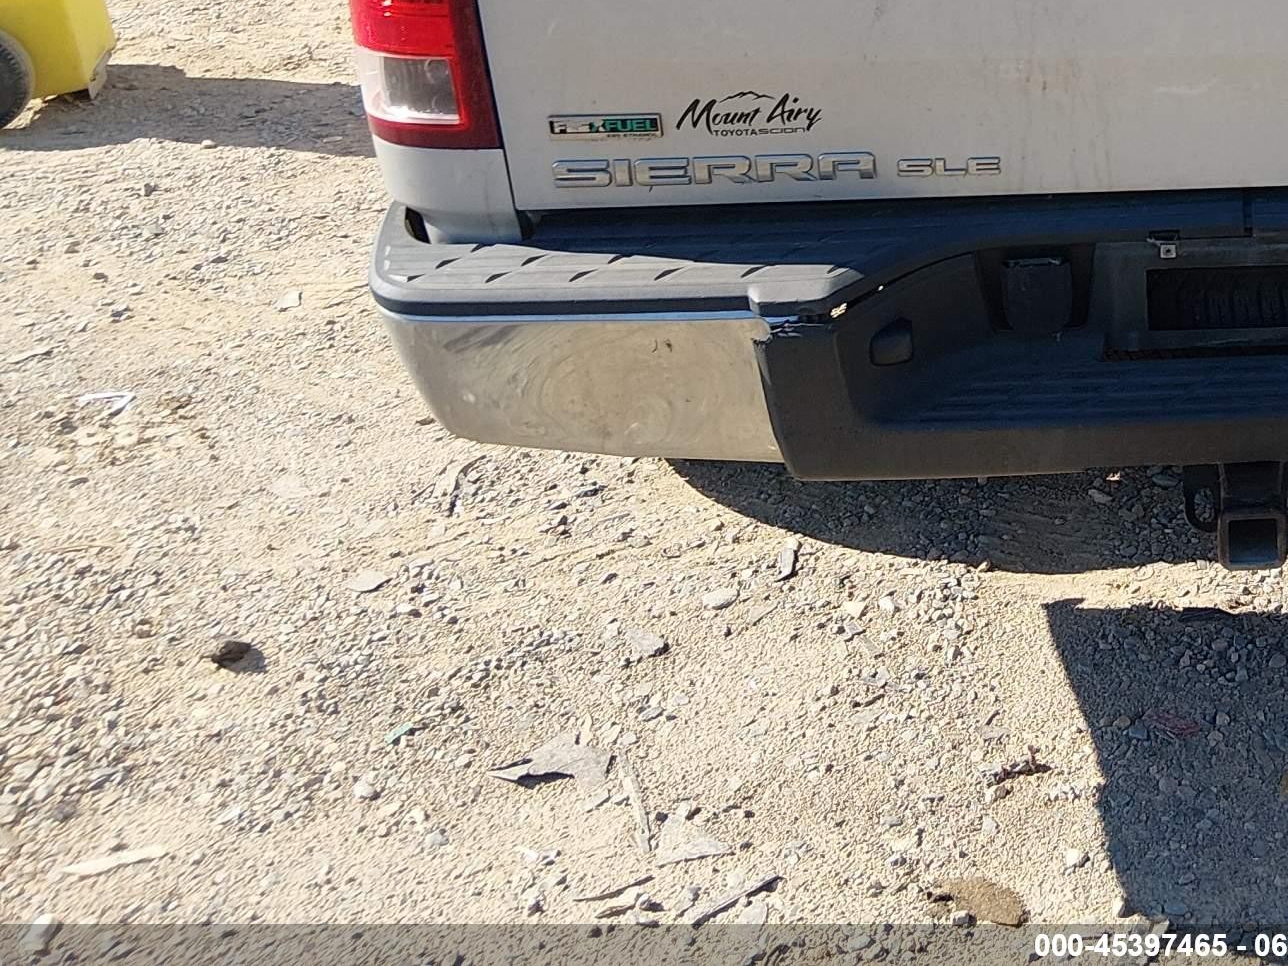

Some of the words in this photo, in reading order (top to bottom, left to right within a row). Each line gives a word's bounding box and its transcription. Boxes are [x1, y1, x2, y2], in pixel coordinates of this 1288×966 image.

[675, 98, 762, 135] Mount
[765, 92, 823, 132] Airy
[551, 150, 877, 188] SIERRA
[896, 156, 1001, 177] SLE
